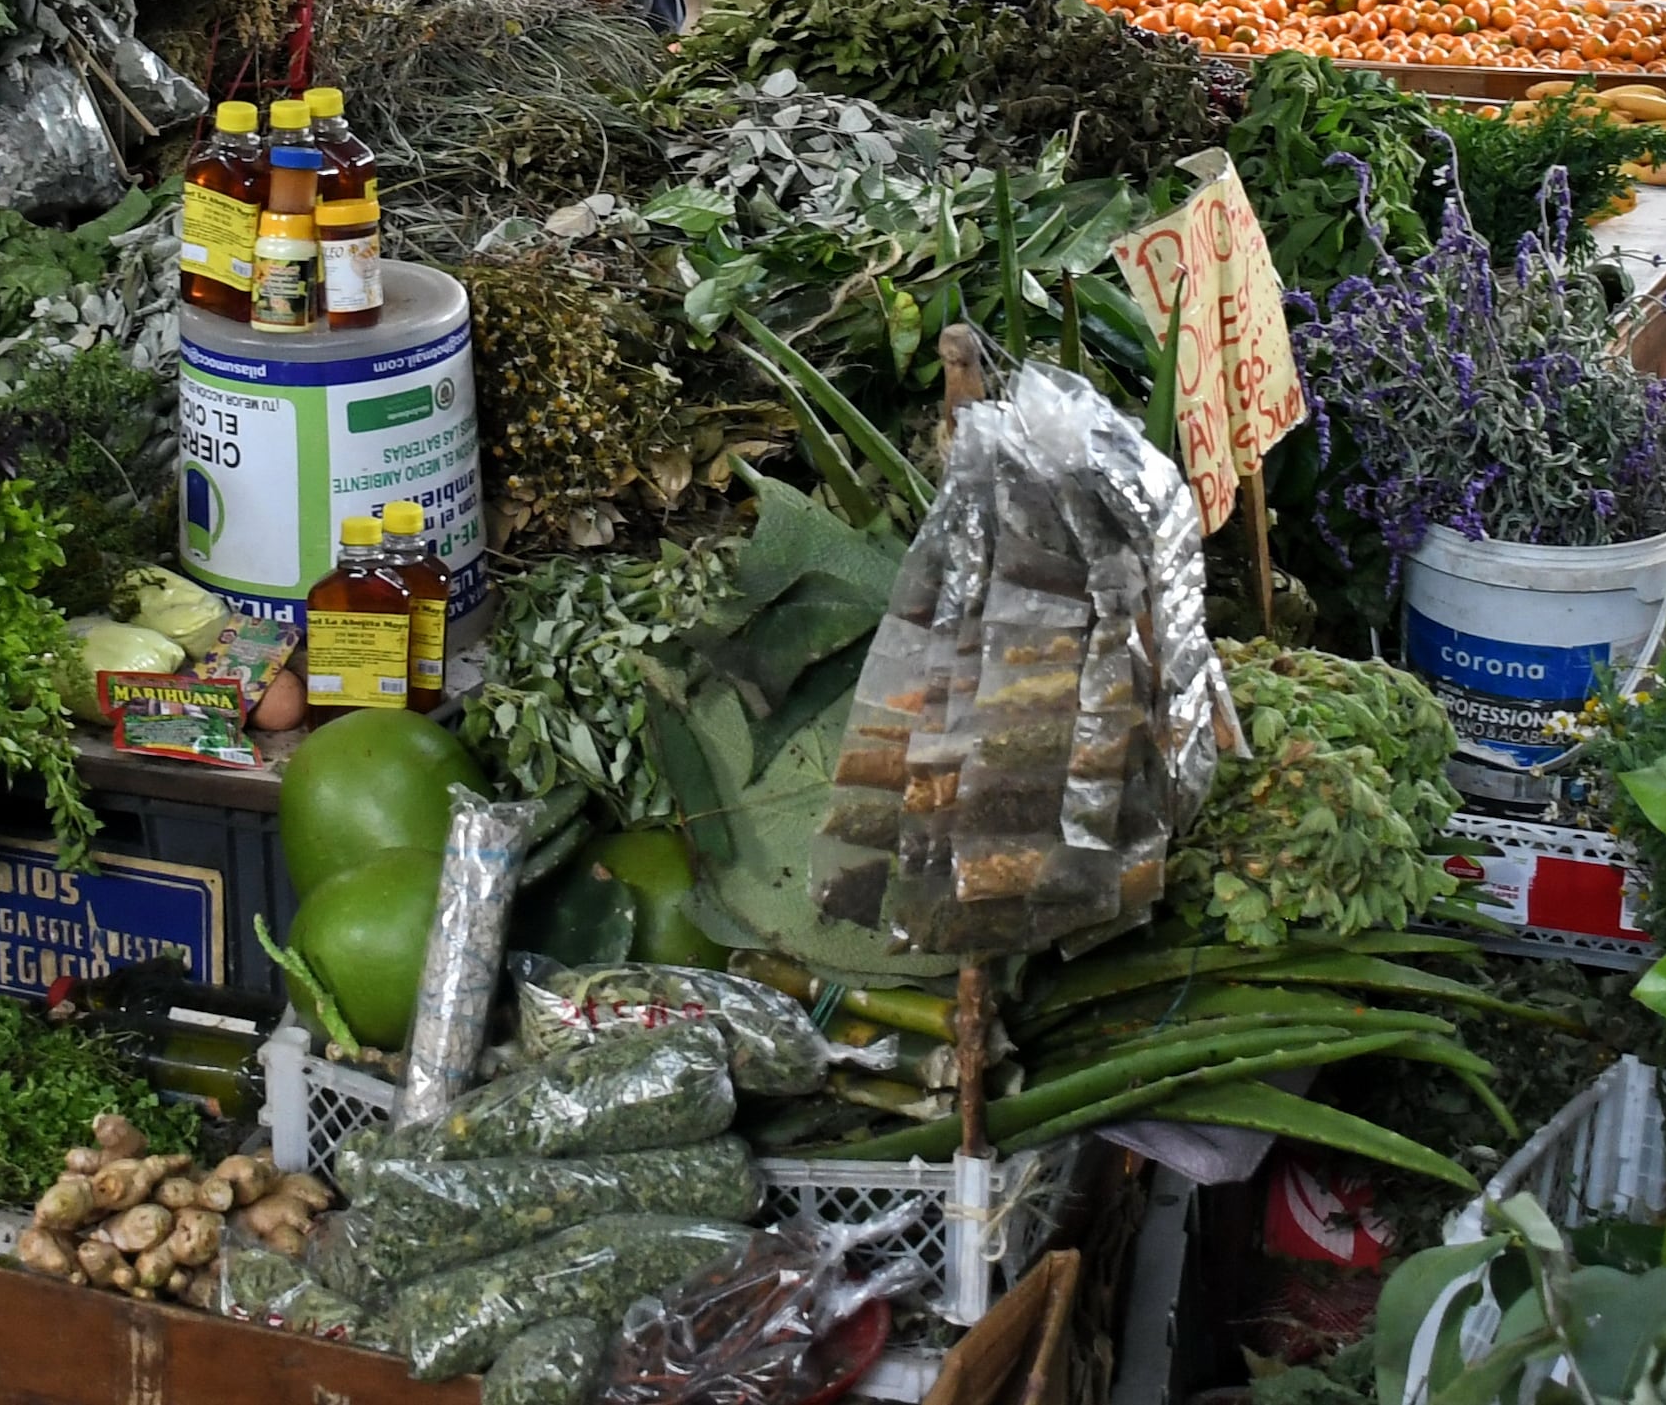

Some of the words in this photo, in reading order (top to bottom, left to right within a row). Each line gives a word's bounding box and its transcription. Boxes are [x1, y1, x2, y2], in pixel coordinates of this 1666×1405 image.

[212, 409, 238, 436] EL
[383, 433, 441, 465] BATERÍAS
[333, 469, 402, 494] AMBIENTE
[405, 460, 441, 482] MEDIO
[440, 507, 455, 530] el
[1440, 646, 1546, 680] corona
[113, 685, 234, 710] MARIHUANA
[1486, 724, 1497, 738] &
